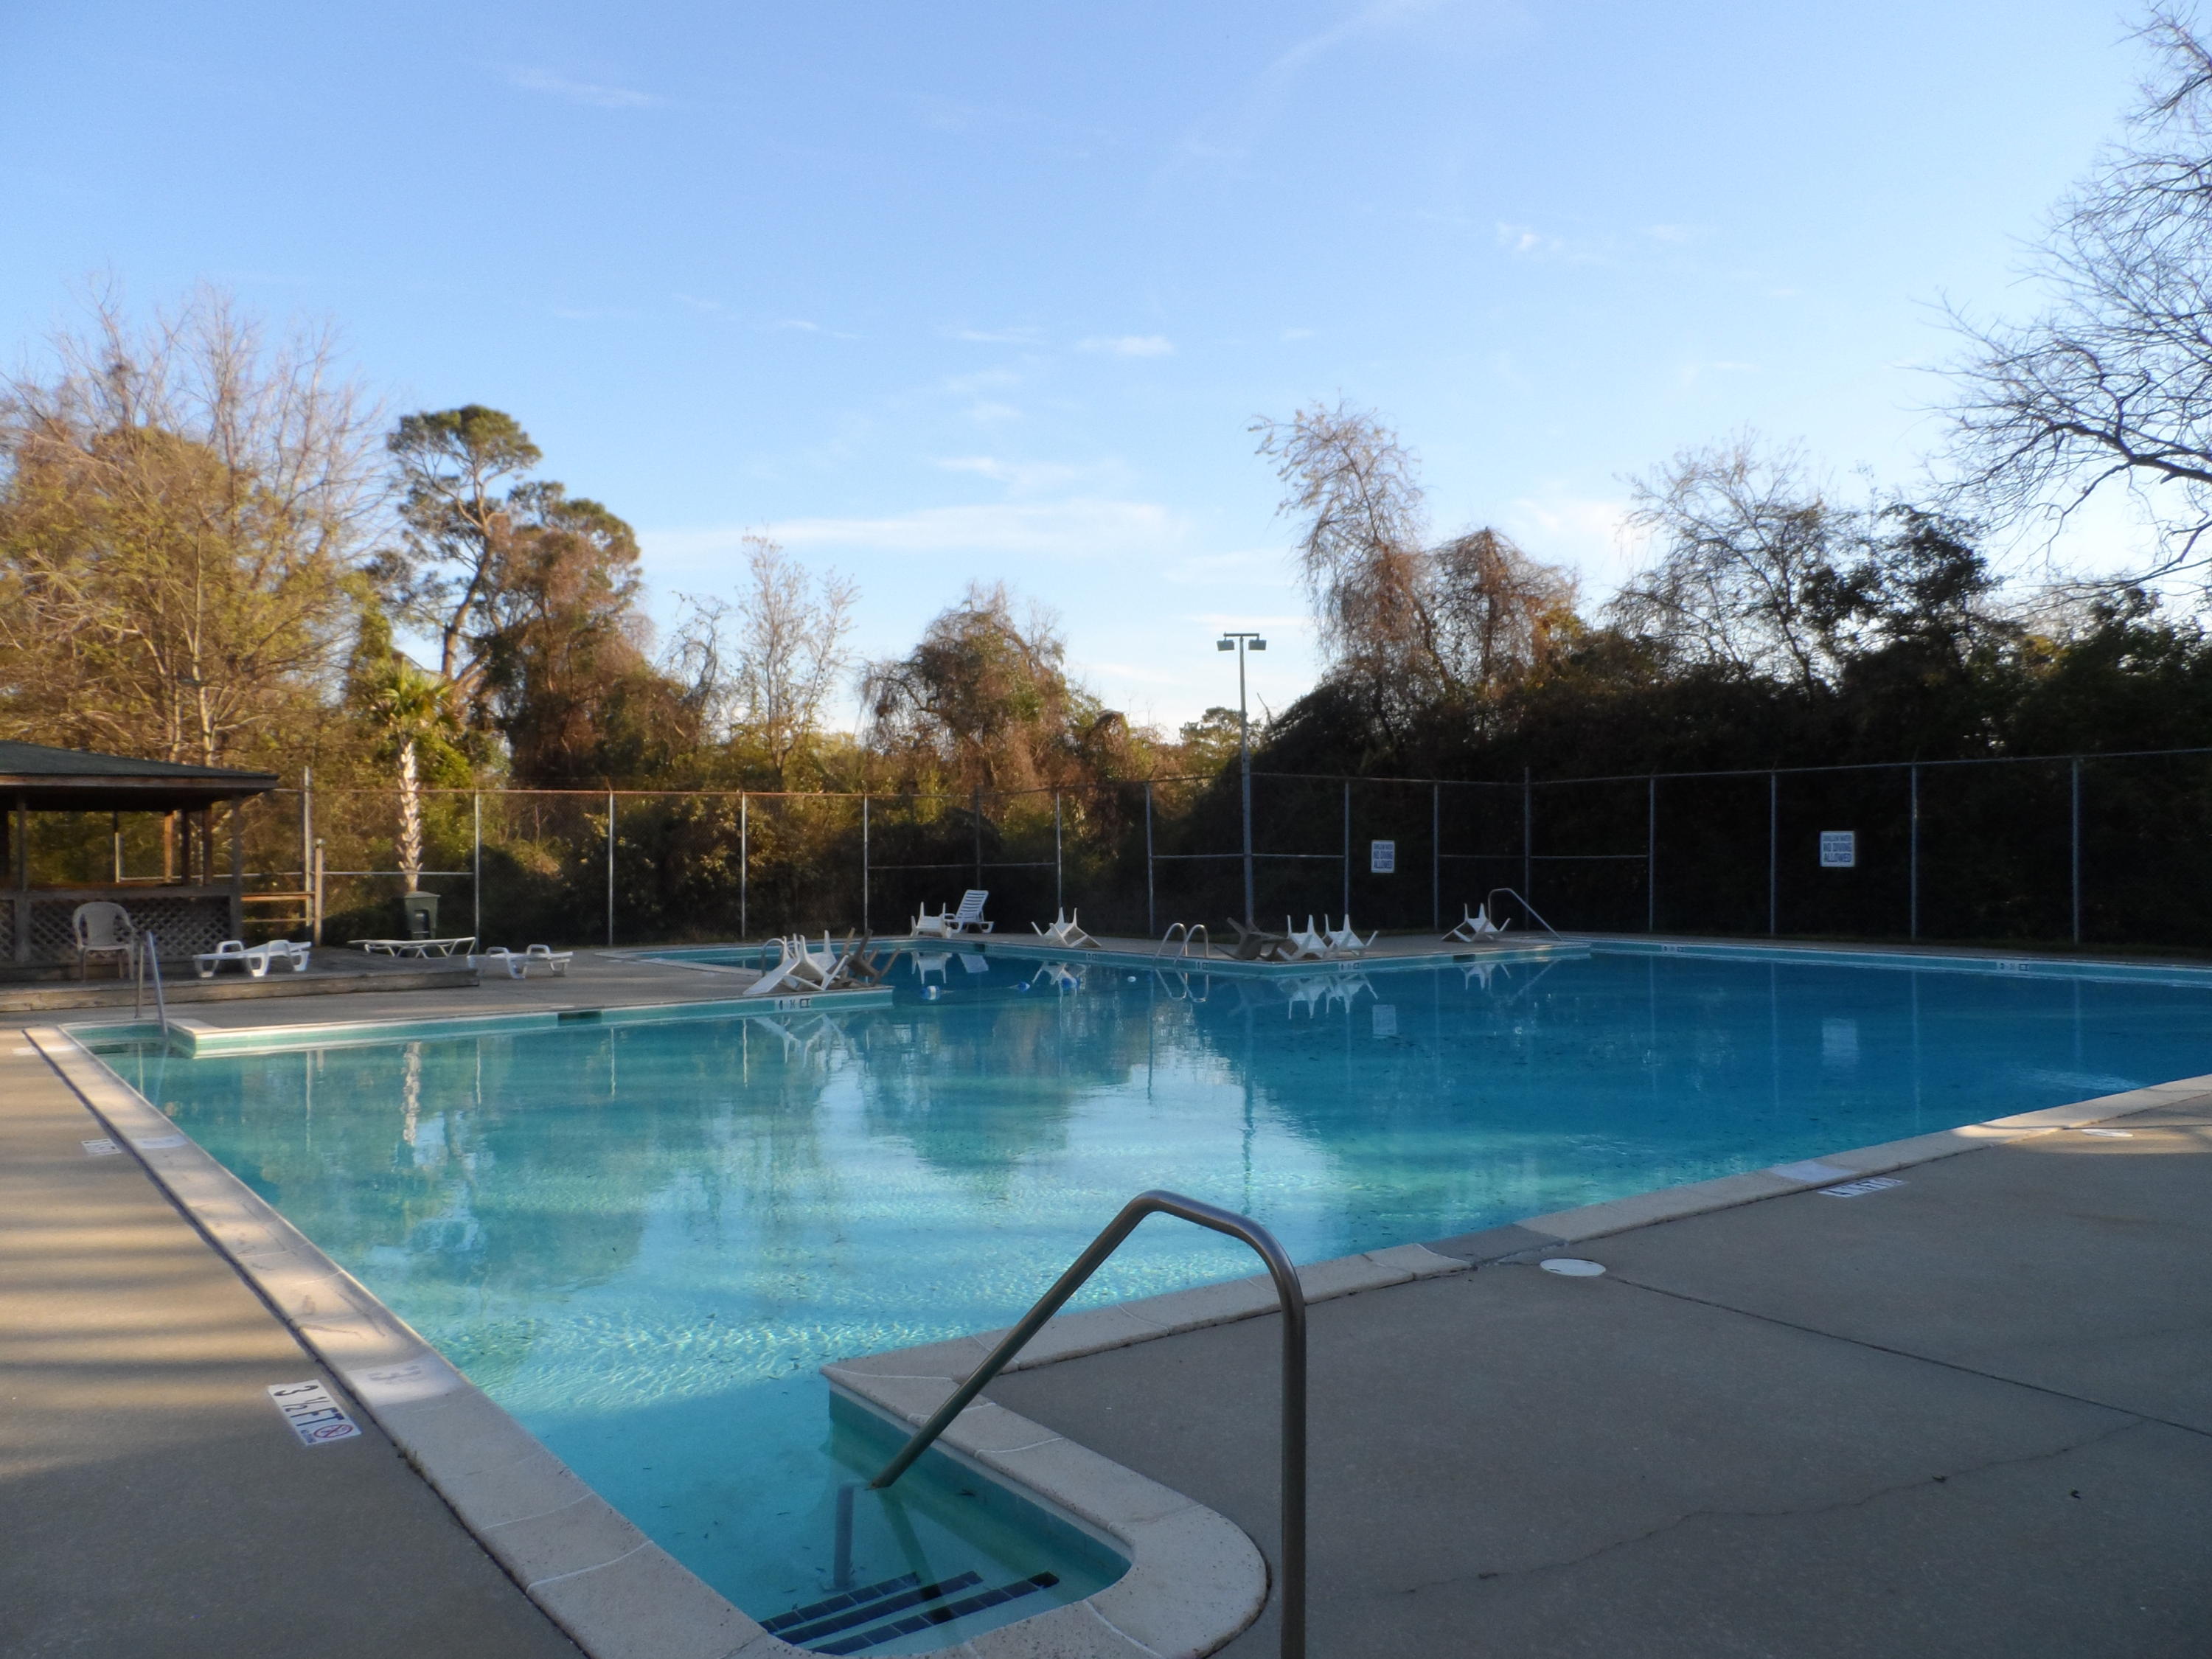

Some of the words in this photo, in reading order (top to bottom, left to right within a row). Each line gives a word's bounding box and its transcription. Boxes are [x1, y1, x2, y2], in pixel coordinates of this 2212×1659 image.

[1823, 843, 1831, 852] NO
[1823, 853, 1851, 862] ALLOWED
[274, 1385, 319, 1397] 3
[290, 1407, 346, 1427] FT
